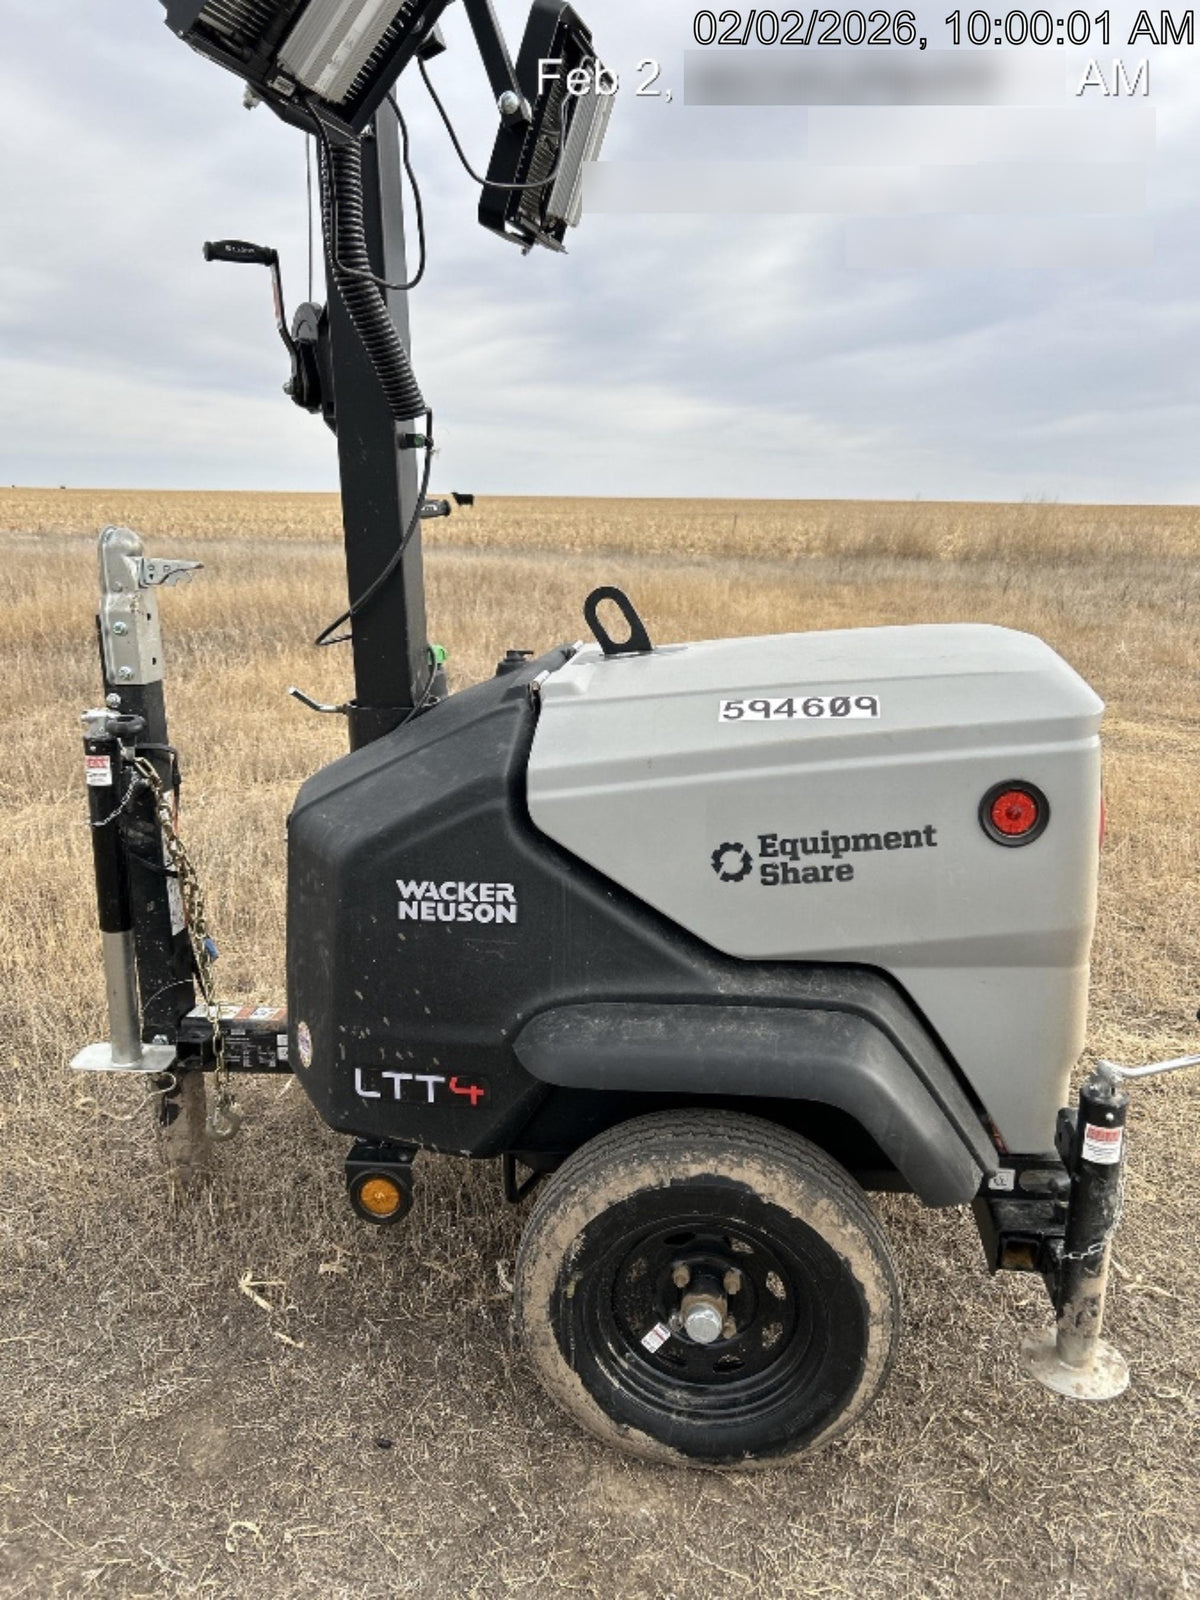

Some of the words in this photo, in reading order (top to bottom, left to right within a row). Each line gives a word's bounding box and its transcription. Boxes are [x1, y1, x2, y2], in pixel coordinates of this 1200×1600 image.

[722, 696, 878, 720] 594609
[757, 825, 938, 861] Equipment
[760, 862, 854, 886] Share
[396, 879, 517, 903] WACKER
[398, 900, 518, 923] NEUSON
[355, 1068, 485, 1106] LTT4
